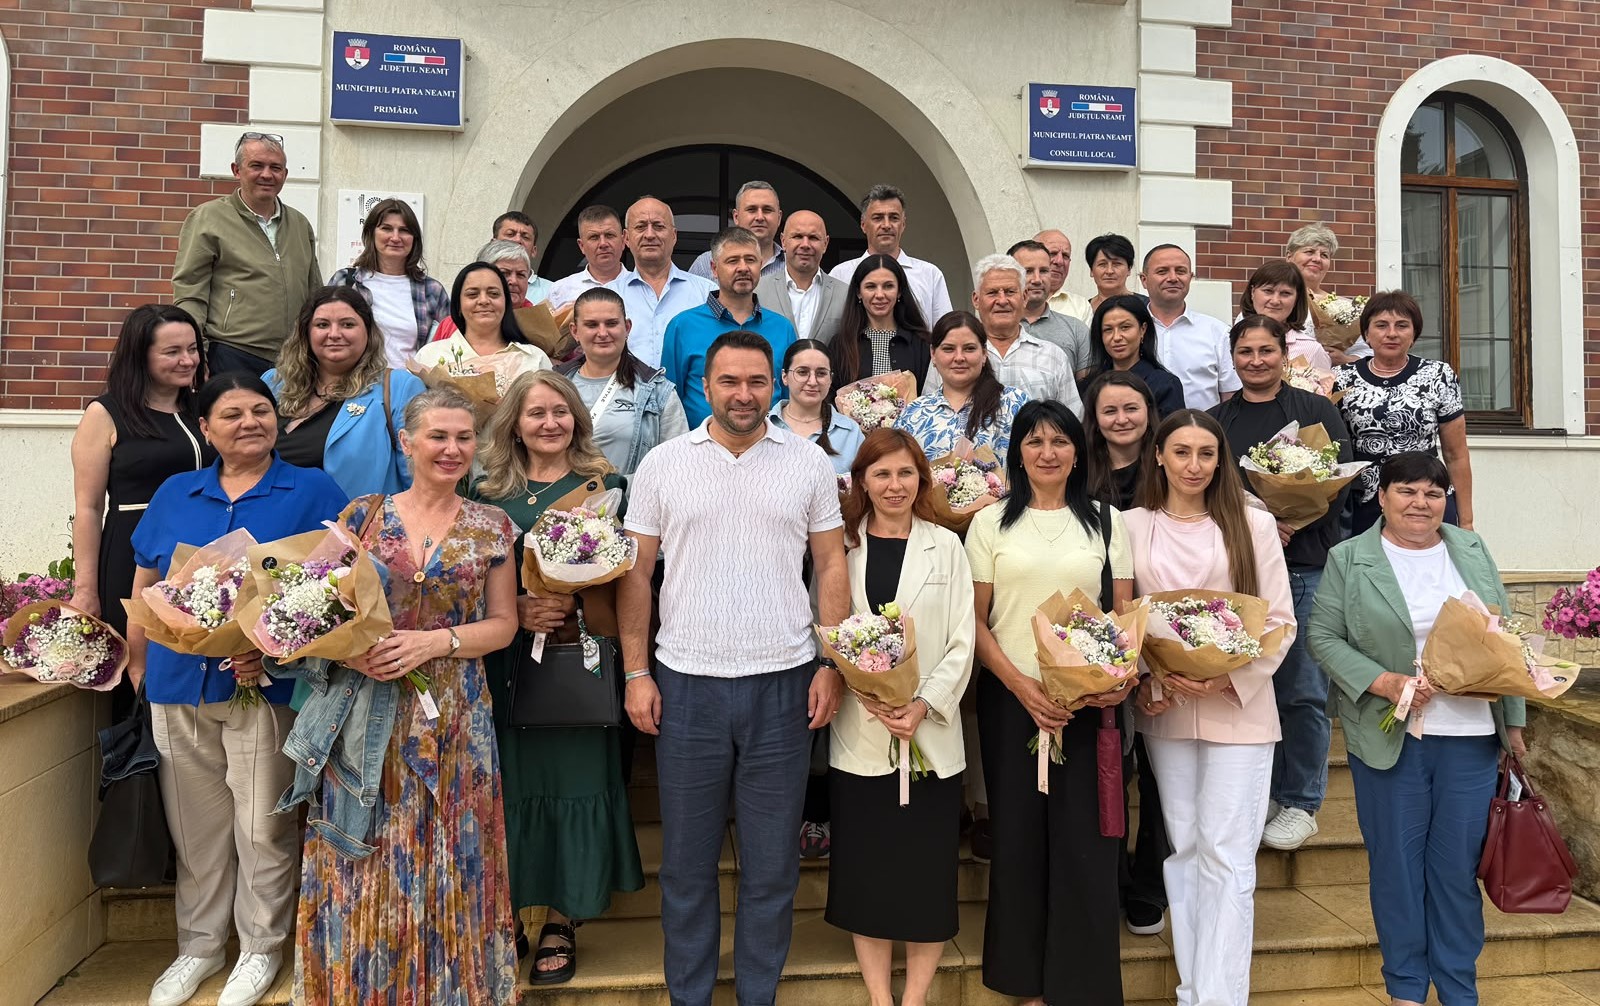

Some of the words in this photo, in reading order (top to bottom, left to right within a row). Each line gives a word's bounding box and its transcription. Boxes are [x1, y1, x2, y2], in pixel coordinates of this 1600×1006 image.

[393, 43, 436, 54] ROMÂNIA
[379, 64, 418, 74] JUDEȚUL
[419, 66, 449, 76] NEAMȚ
[336, 83, 390, 94] MUNICIPIUL
[391, 86, 424, 96] PIATRA
[425, 89, 456, 99] NEAMȚ
[1079, 93, 1115, 102] ROMÂNIA
[373, 105, 418, 115] PRIMĂRIA
[1068, 112, 1100, 121] JUDEȚUL
[1100, 113, 1126, 122] NEAMȚ
[1033, 131, 1077, 139] MUNICIPIUL
[1106, 134, 1132, 142] NEAMȚ
[1049, 150, 1090, 158] CONSILIUL
[1090, 150, 1116, 159] LOCAL
